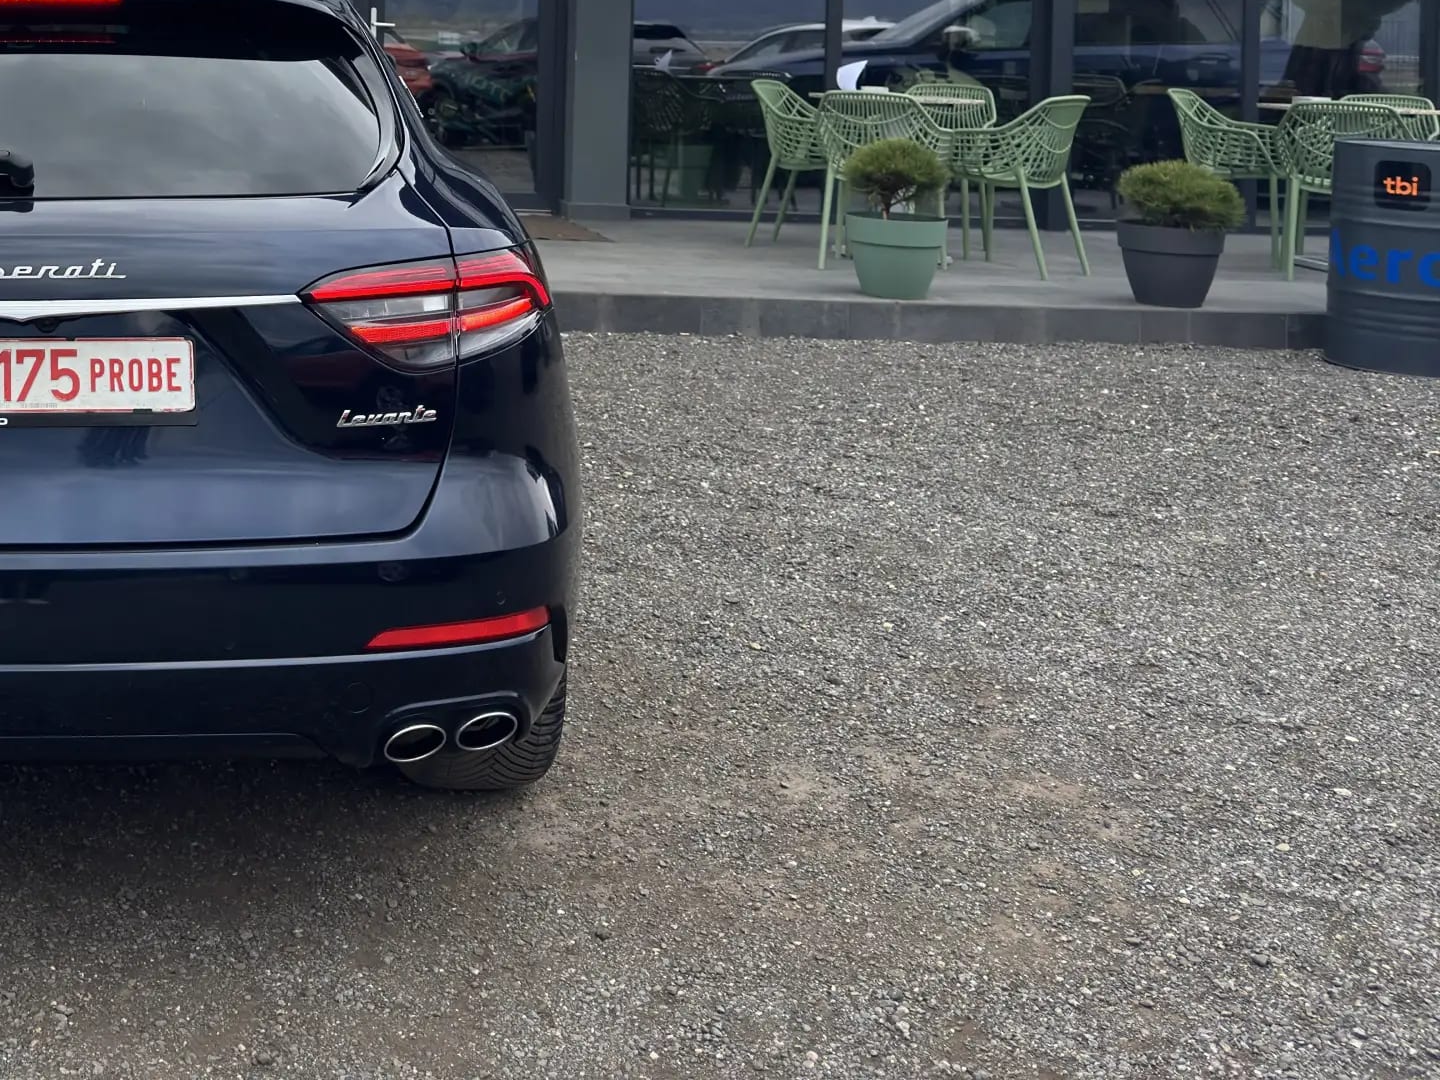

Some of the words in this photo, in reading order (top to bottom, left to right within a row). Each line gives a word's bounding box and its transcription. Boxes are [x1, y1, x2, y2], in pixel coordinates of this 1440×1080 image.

[1383, 176, 1418, 196] tbi
[89, 357, 183, 393] PROBE
[336, 405, 437, 427] Levante
